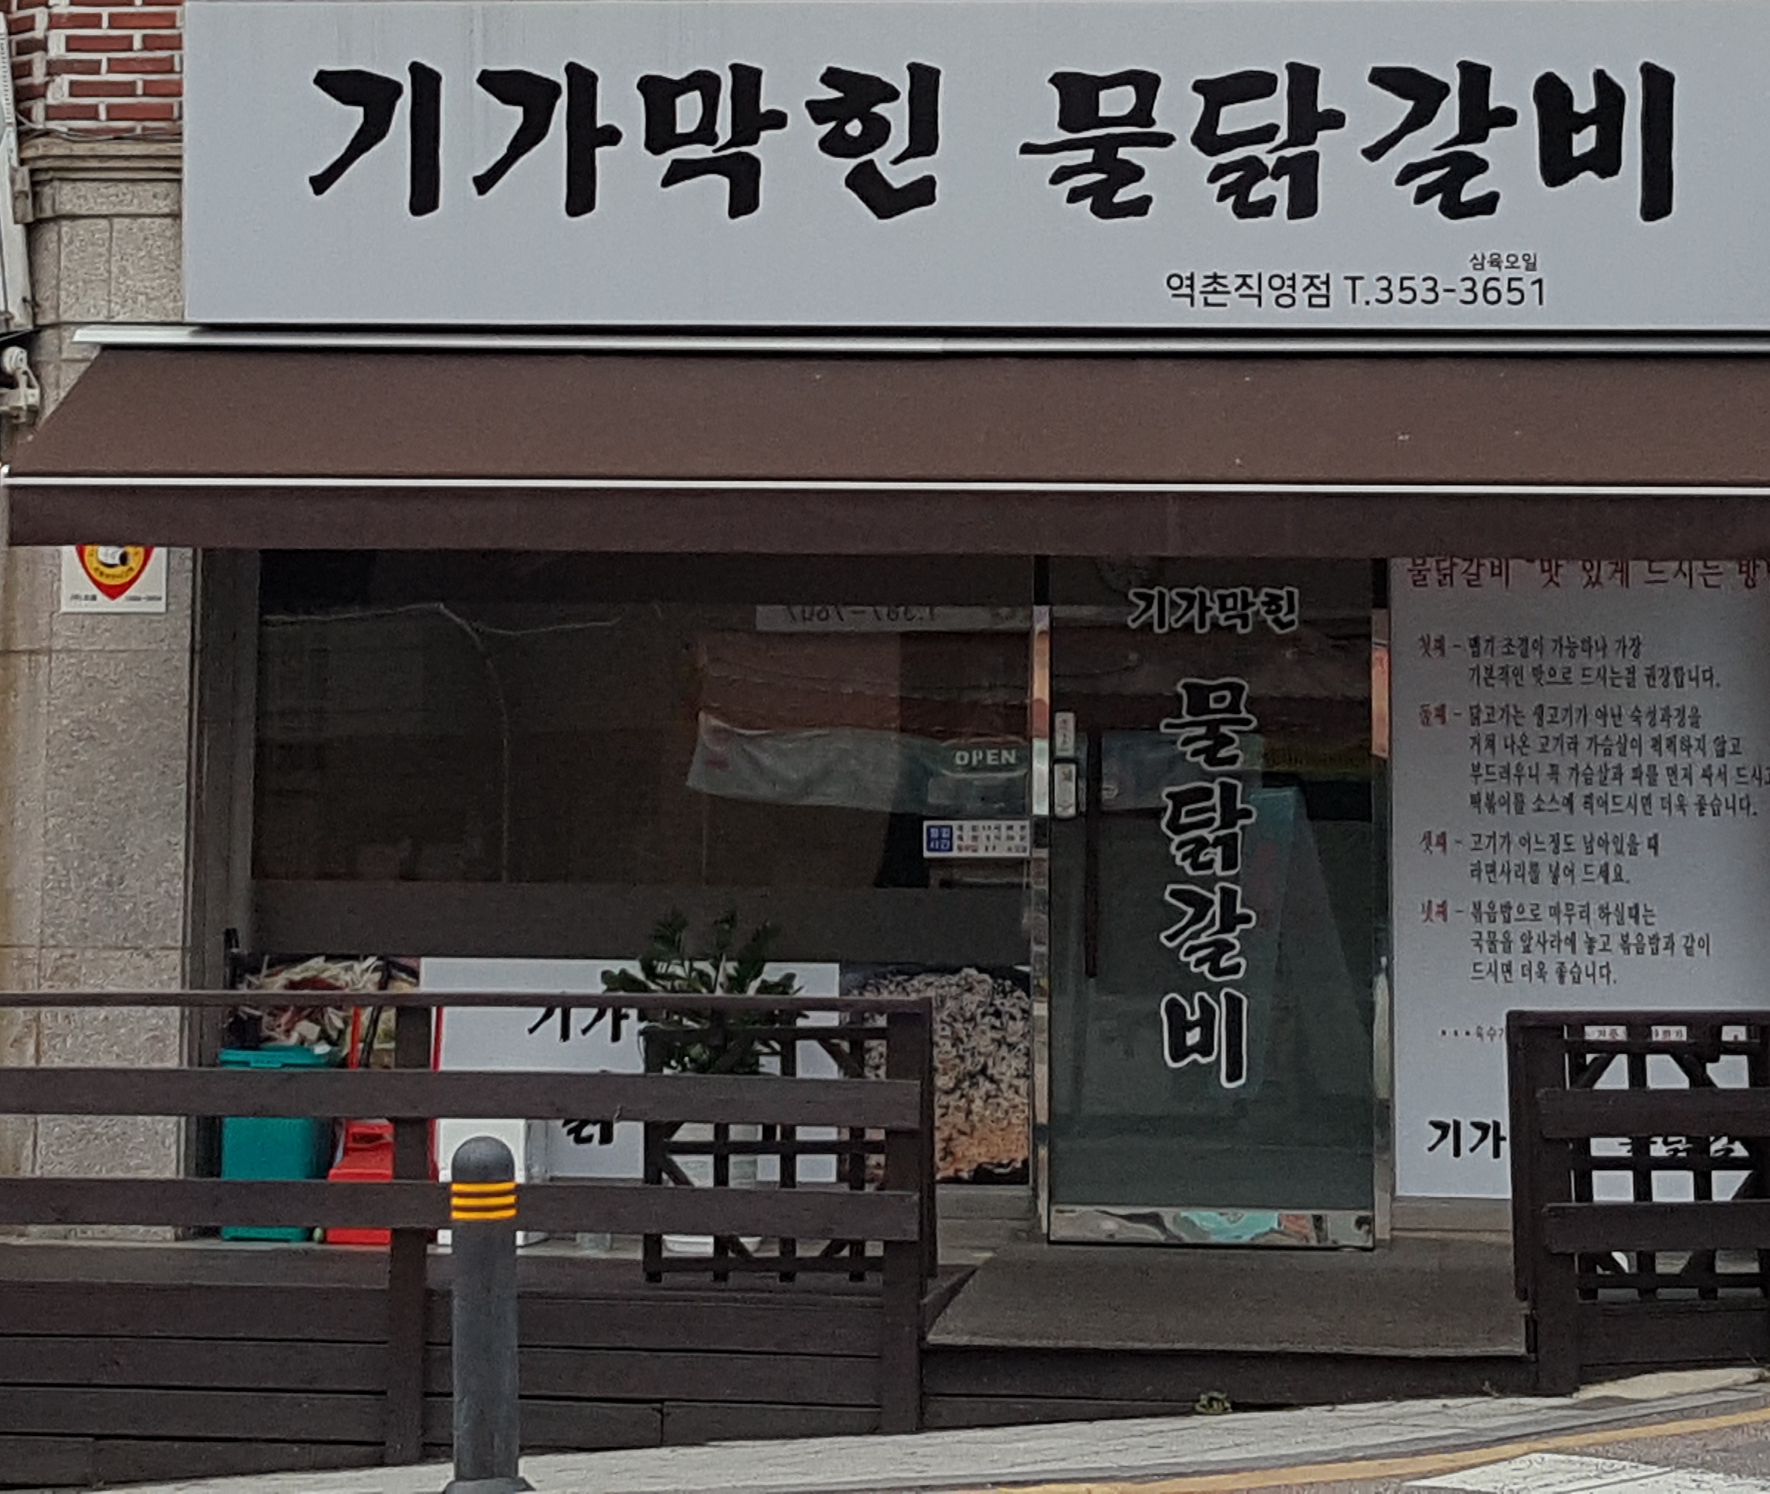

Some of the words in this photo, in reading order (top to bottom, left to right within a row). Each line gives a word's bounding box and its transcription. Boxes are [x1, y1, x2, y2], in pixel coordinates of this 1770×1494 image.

[308, 61, 942, 220] 기가막힌
[1017, 60, 1676, 223] 물닭갈비
[1469, 253, 1539, 272] 삼육오일
[1165, 271, 1332, 309] 역촌직영점
[1343, 275, 1547, 309] T.353-3651
[1407, 557, 1511, 589] 물닭갈비
[1540, 558, 1564, 589] 맛
[1581, 558, 1631, 589] 있게
[1644, 559, 1724, 589] 드시는
[1127, 585, 1299, 635] 기가막힌
[1419, 634, 1446, 657] 첫째
[1615, 634, 1642, 659] 가장
[1469, 664, 1524, 688] 기본적인
[1532, 664, 1574, 687] 맛으로
[1419, 704, 1446, 727] 둘째
[1468, 703, 1526, 727] 닭고기는
[1533, 703, 1587, 728] 생고기가
[1595, 704, 1622, 728] 아닌
[1504, 732, 1530, 756] 나온
[1587, 733, 1642, 757] 가슴살이
[954, 749, 1017, 766] OPEN
[1470, 762, 1539, 786] 부드러우니
[1568, 762, 1623, 787] 가슴살과
[1666, 763, 1692, 787] 먼저
[1533, 792, 1574, 816] 소스에
[1660, 793, 1688, 817] 더욱
[1695, 793, 1758, 817] 좋습니다.
[1470, 830, 1510, 855] 고기가
[1518, 831, 1576, 855] 어느정도
[1583, 831, 1640, 856] 남아있을
[1160, 677, 1258, 1088] 물닭갈비
[1470, 859, 1540, 885] 라면사리를
[1582, 861, 1630, 885] 드세요.
[1421, 900, 1448, 923] 넷째
[1471, 900, 1542, 924] 볶음밥으로
[1549, 901, 1590, 925] 마무리
[1471, 930, 1513, 954] 국물을
[1584, 931, 1612, 955] 놓고
[1620, 932, 1675, 956] 볶음밥과
[1683, 933, 1710, 957] 같이
[1471, 959, 1514, 984] 드시면
[1521, 960, 1548, 984] 더욱
[1556, 961, 1617, 985] 좋습니다.
